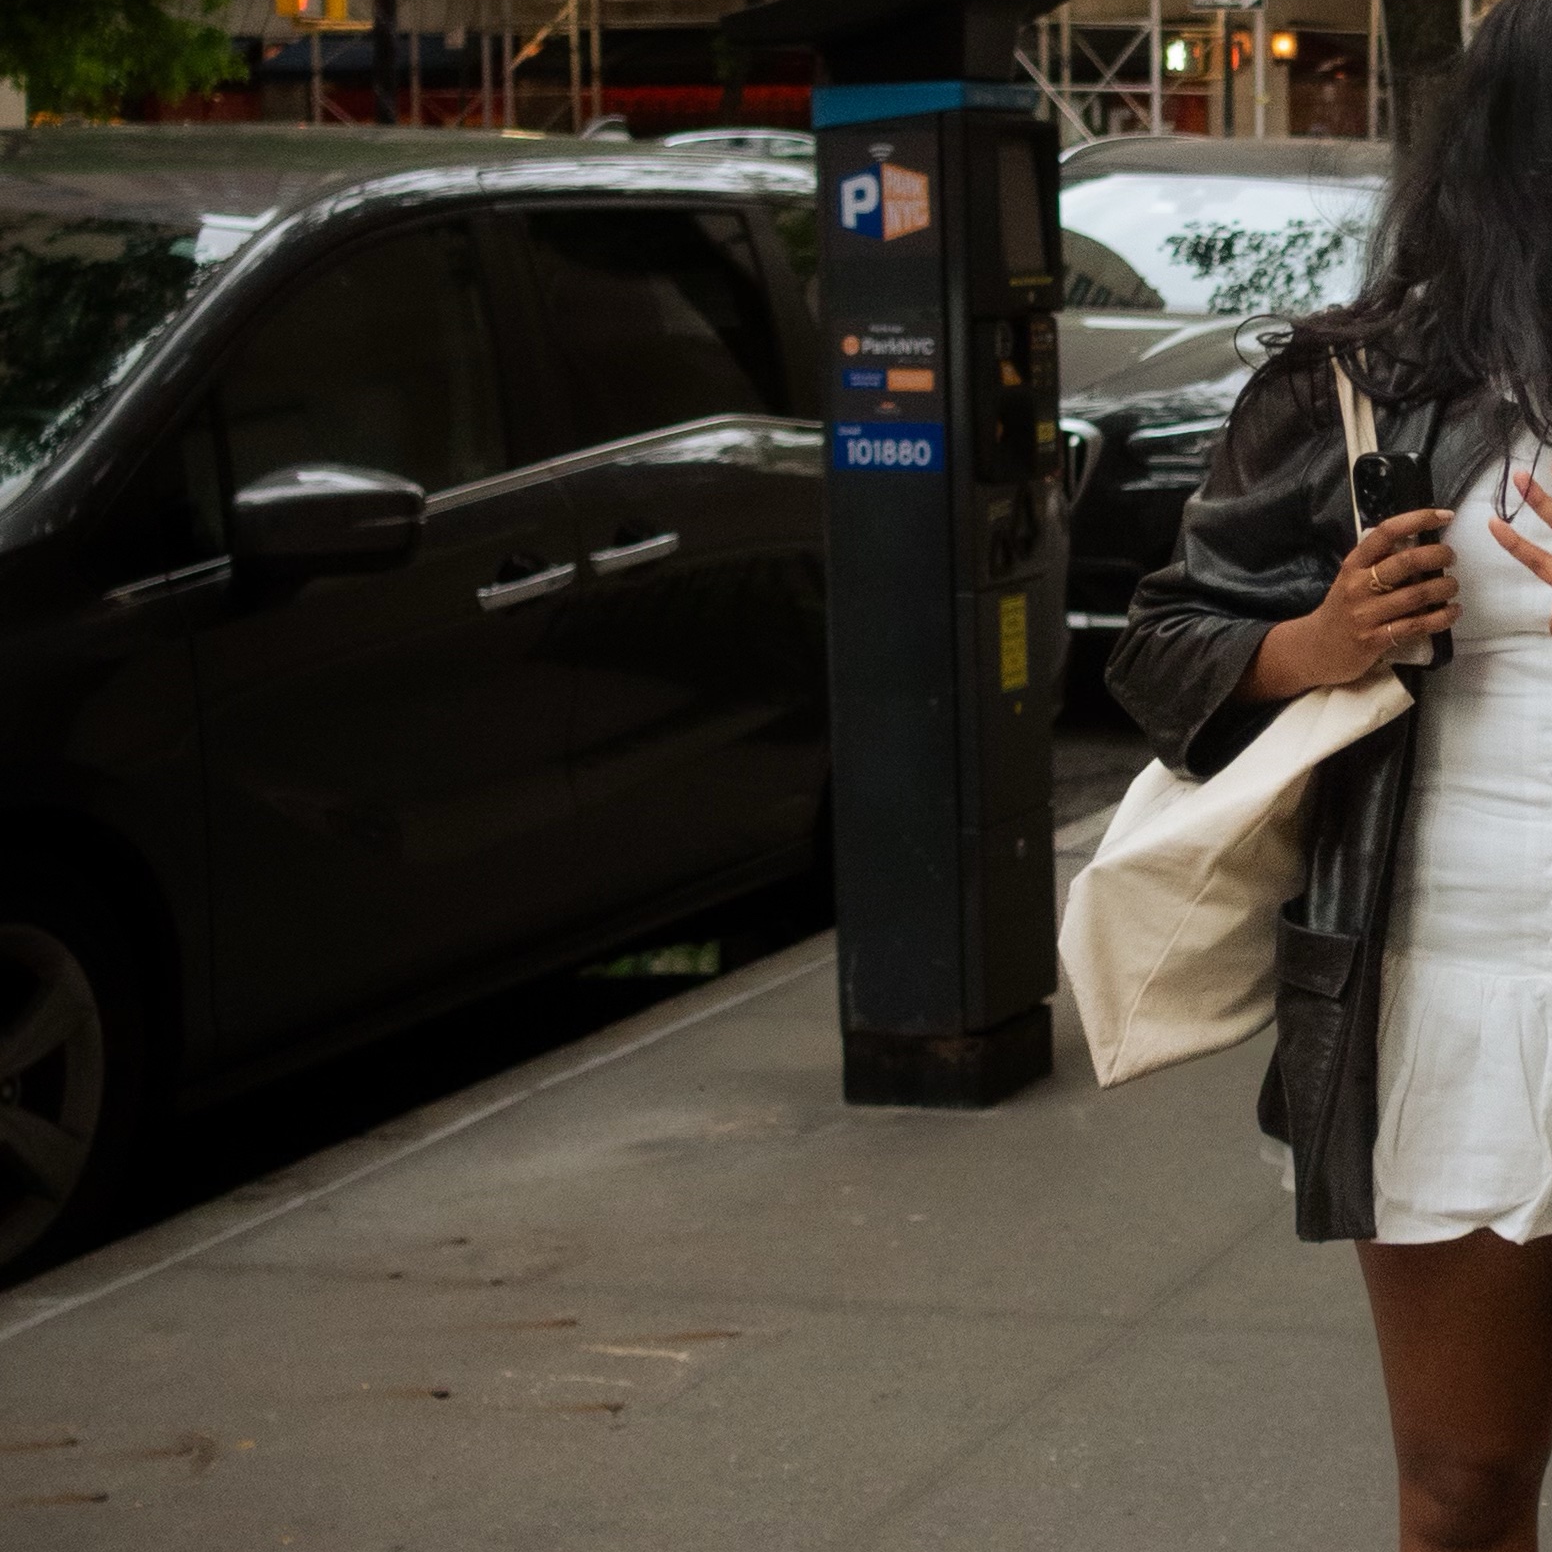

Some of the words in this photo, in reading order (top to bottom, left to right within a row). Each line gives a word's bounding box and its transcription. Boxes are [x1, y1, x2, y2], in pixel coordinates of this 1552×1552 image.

[841, 173, 879, 229] P
[861, 337, 935, 356] ParkNYC
[847, 438, 932, 466] 101880
